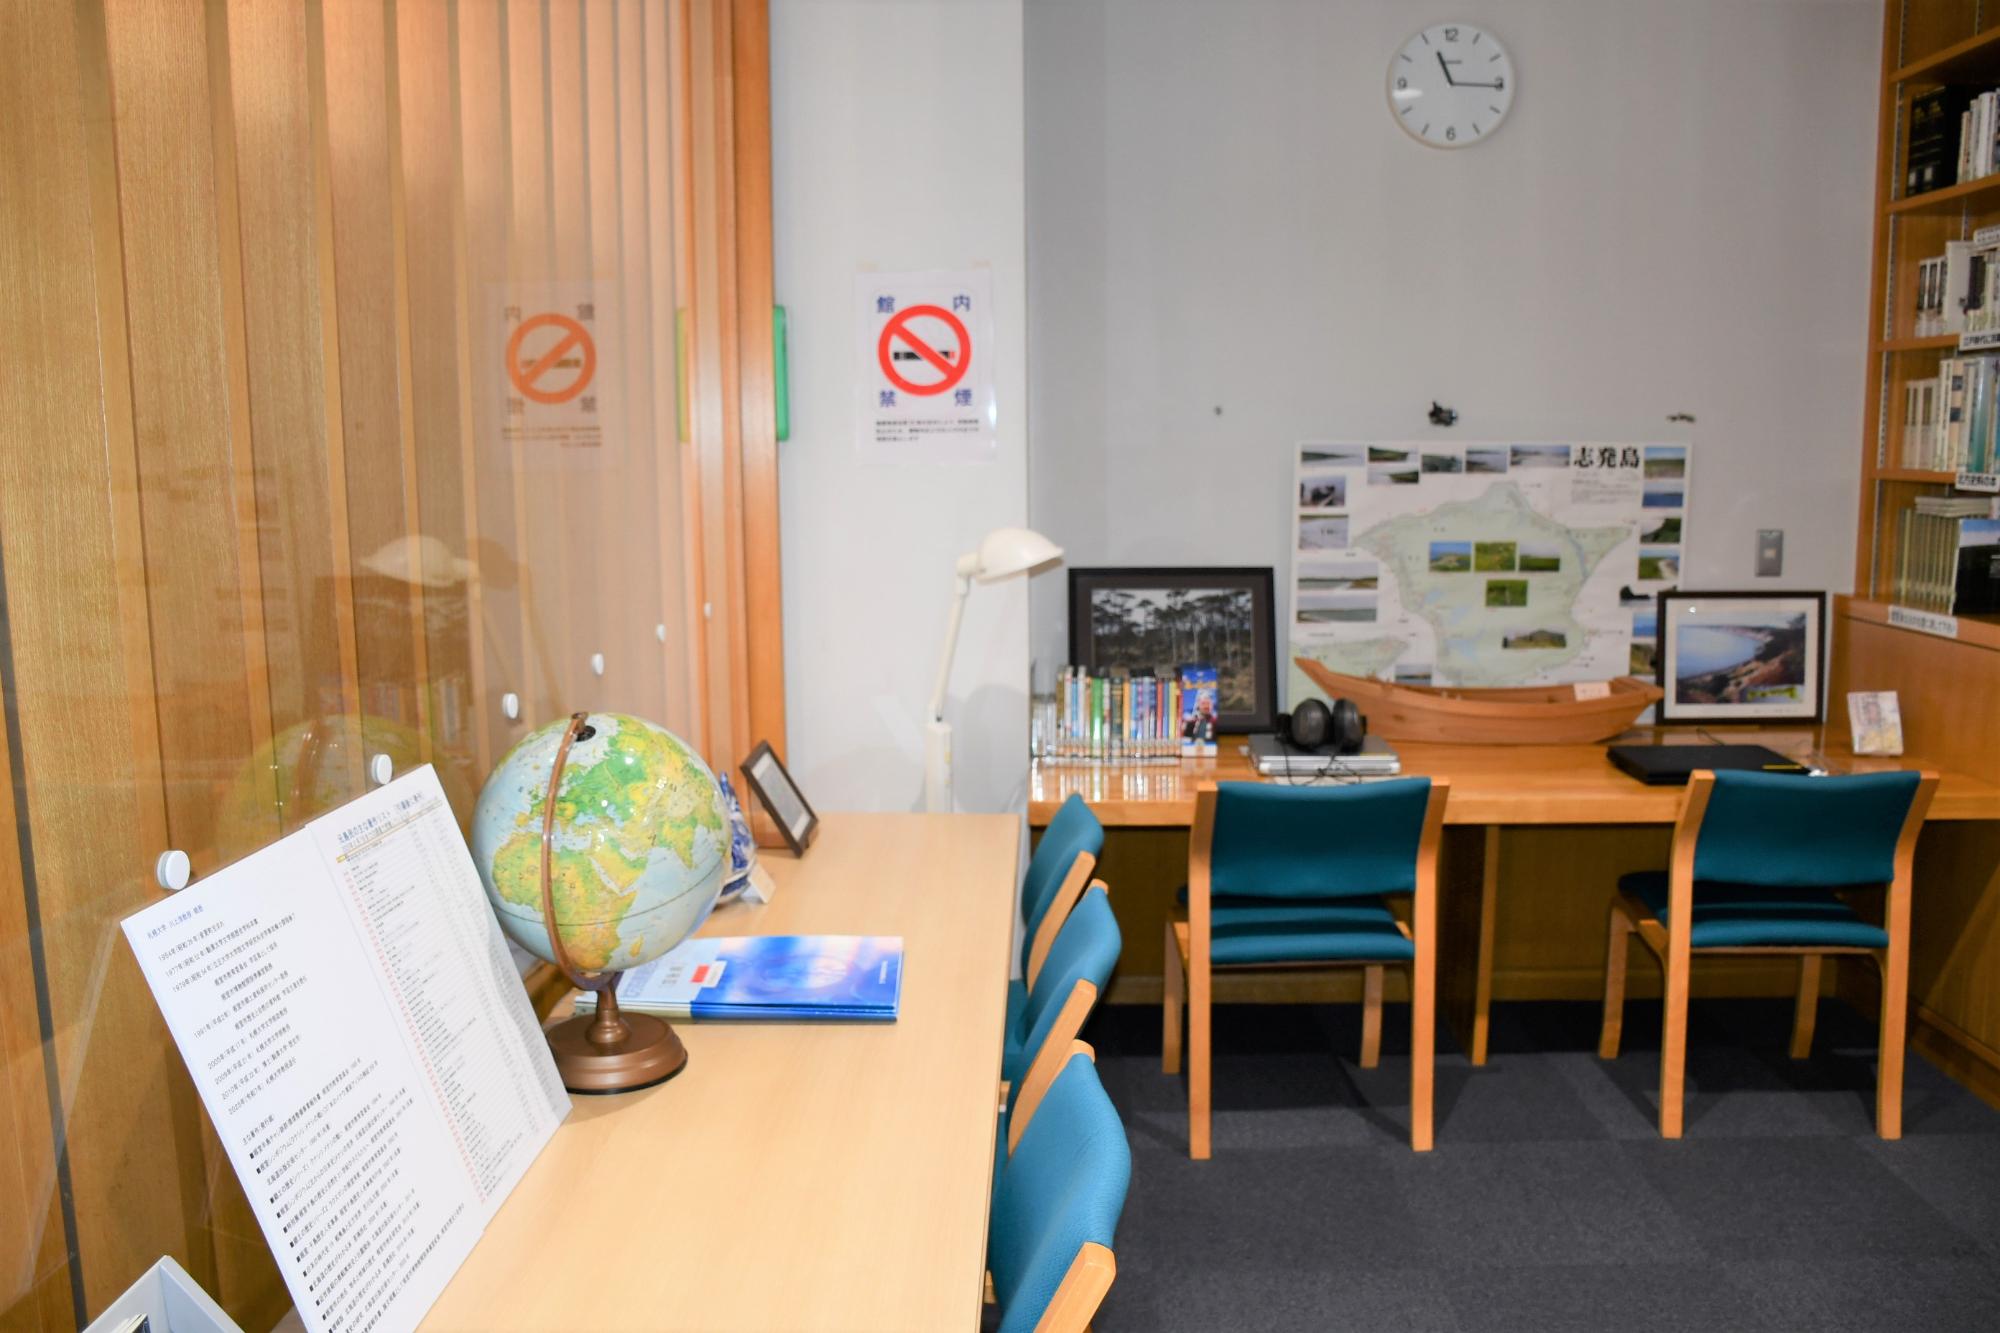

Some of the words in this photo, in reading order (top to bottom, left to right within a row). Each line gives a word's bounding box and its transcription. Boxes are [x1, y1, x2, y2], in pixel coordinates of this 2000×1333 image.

[1445, 29, 1459, 42] 12
[1397, 77, 1408, 89] 9
[1495, 76, 1504, 91] 3
[1446, 126, 1456, 141] 6
[953, 295, 971, 312] 内
[1573, 445, 1640, 469] 志発島
